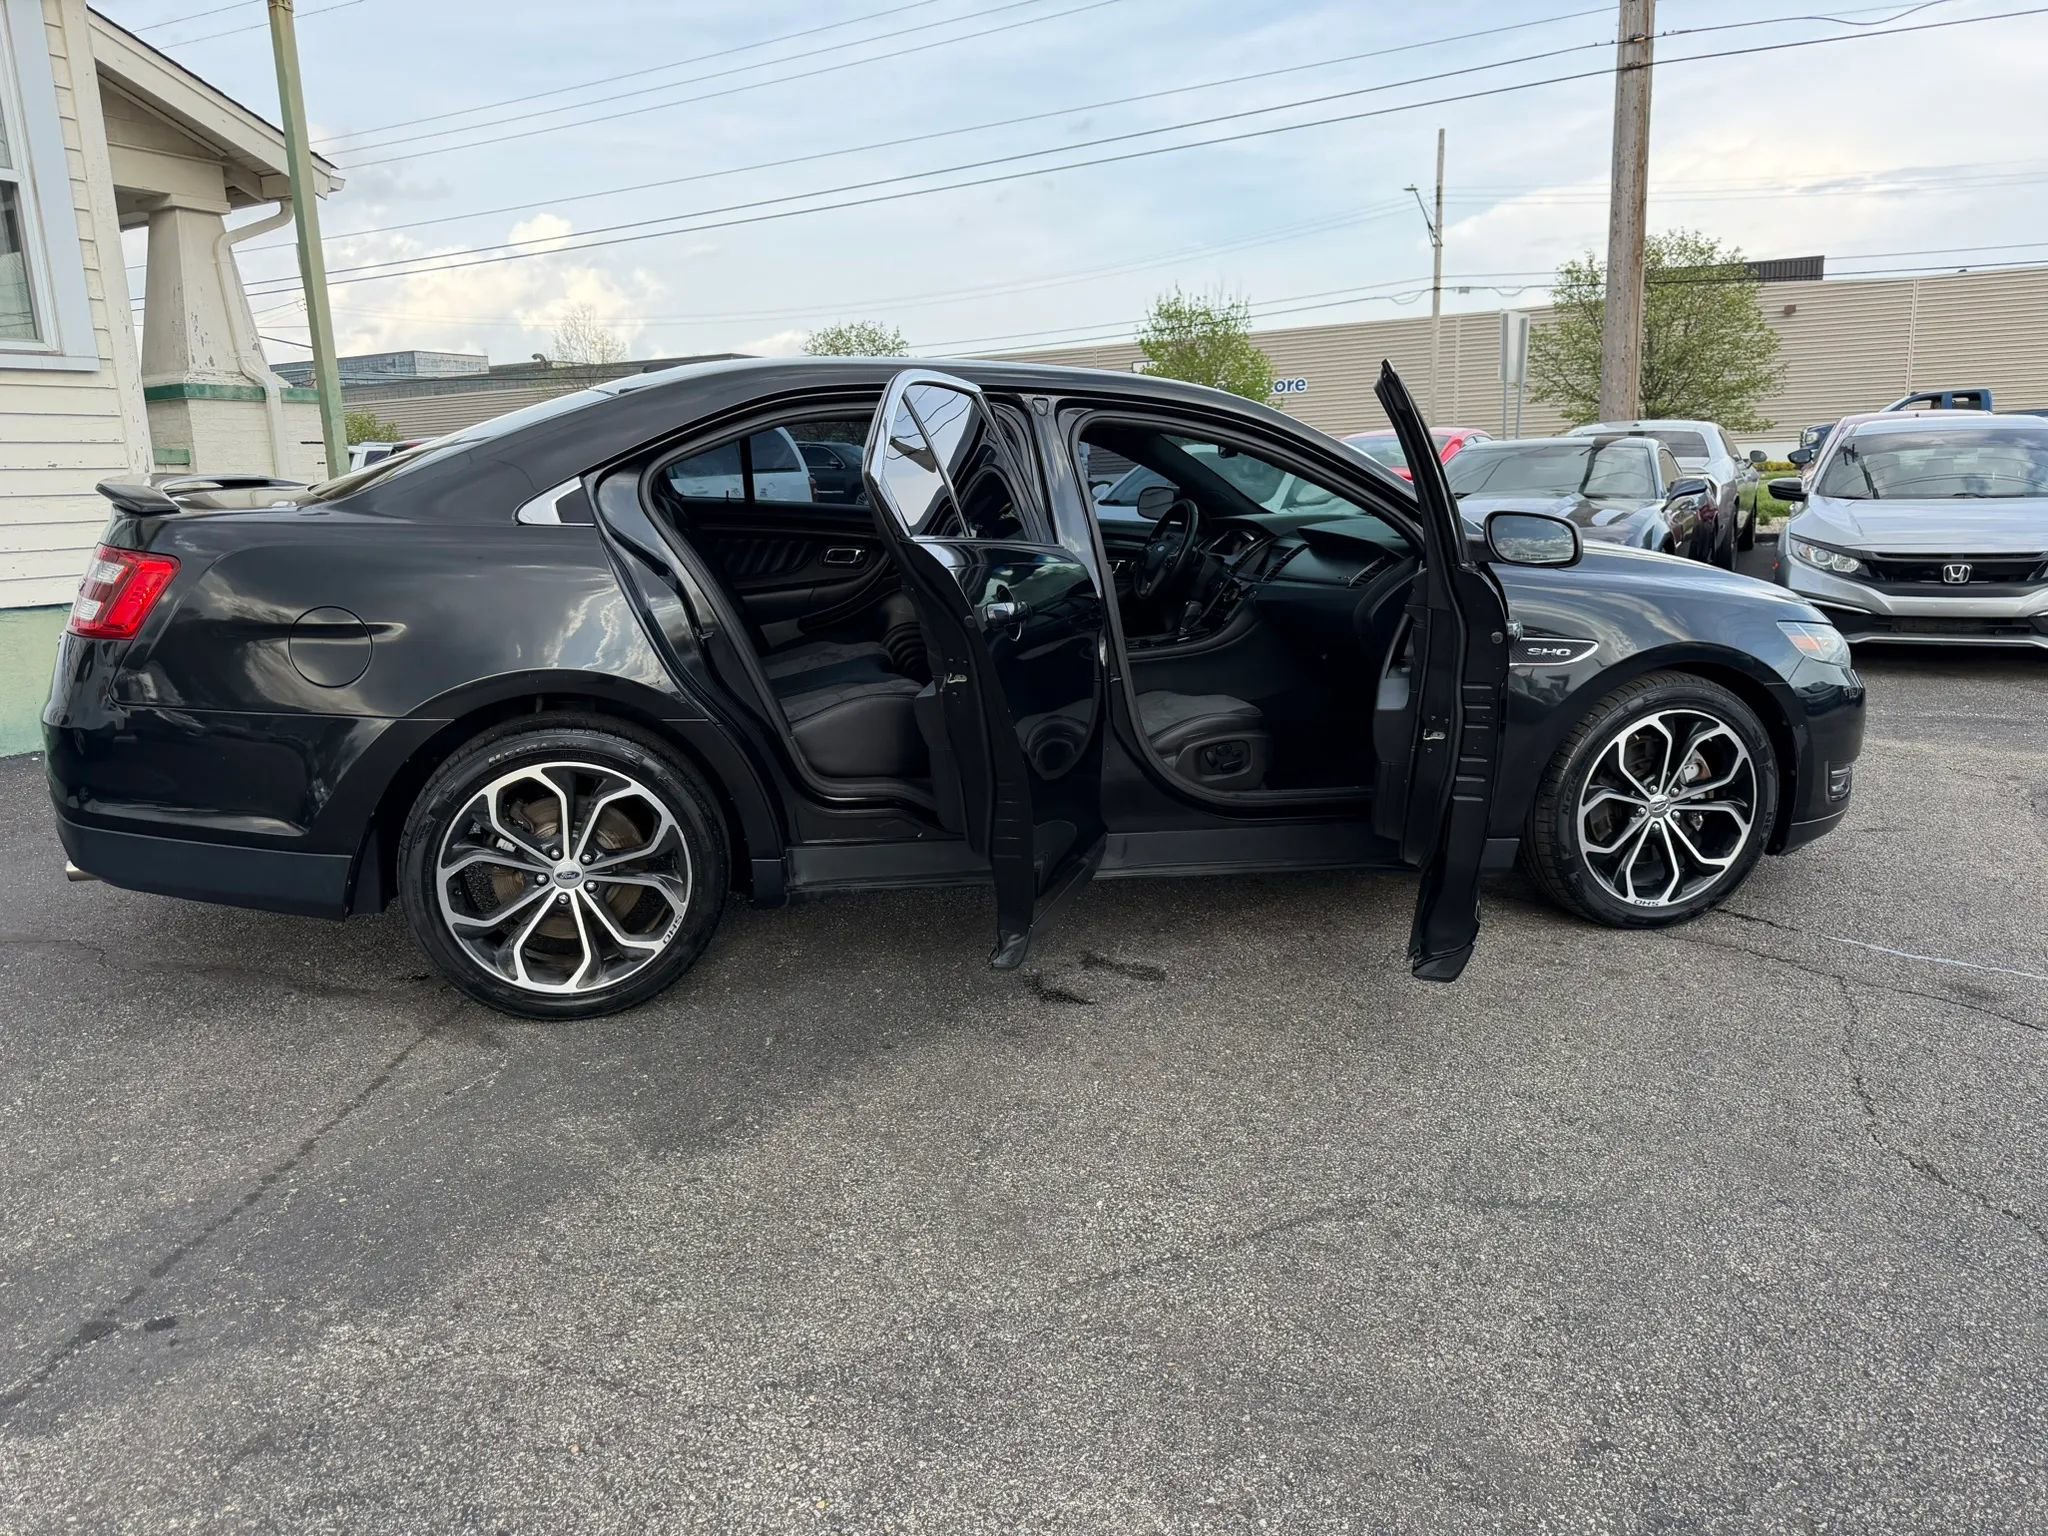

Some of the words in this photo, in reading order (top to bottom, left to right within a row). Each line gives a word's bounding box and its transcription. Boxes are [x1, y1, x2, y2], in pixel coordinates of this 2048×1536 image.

[1272, 379, 1306, 392] ore
[1527, 647, 1571, 656] SHO
[663, 914, 682, 944] SHO
